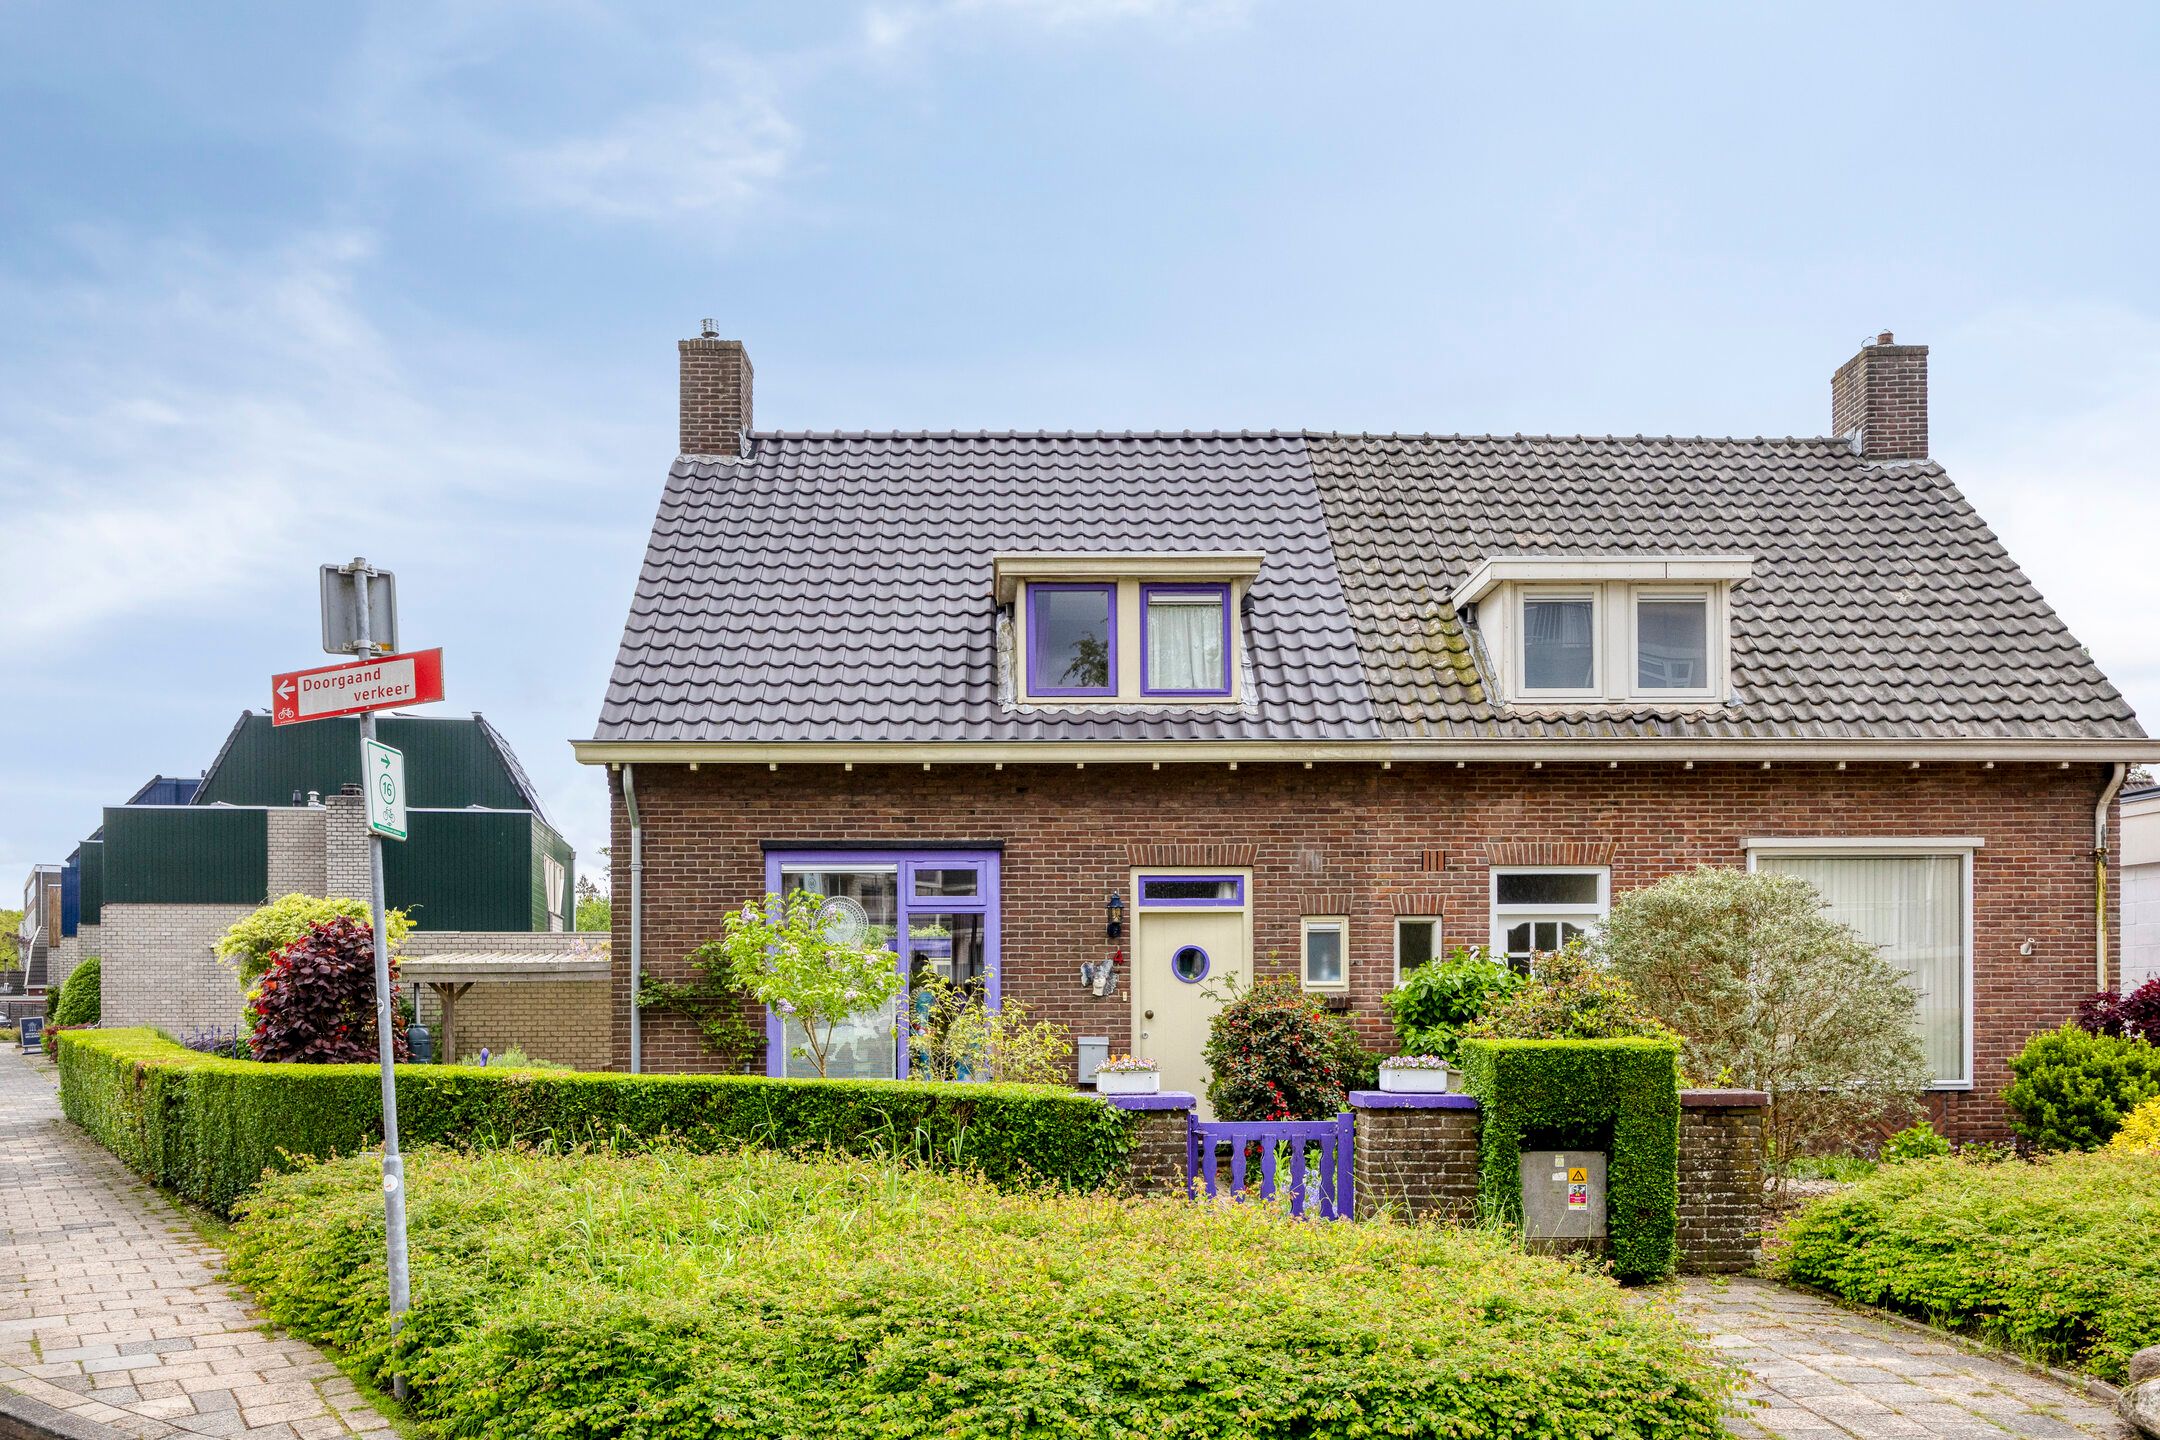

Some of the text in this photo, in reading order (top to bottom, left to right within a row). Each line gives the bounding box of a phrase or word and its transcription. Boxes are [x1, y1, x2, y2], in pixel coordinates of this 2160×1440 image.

[303, 668, 381, 691] Doorgaand
[354, 683, 410, 701] verkeer
[382, 781, 392, 797] 16
[1113, 949, 1124, 965] 4
